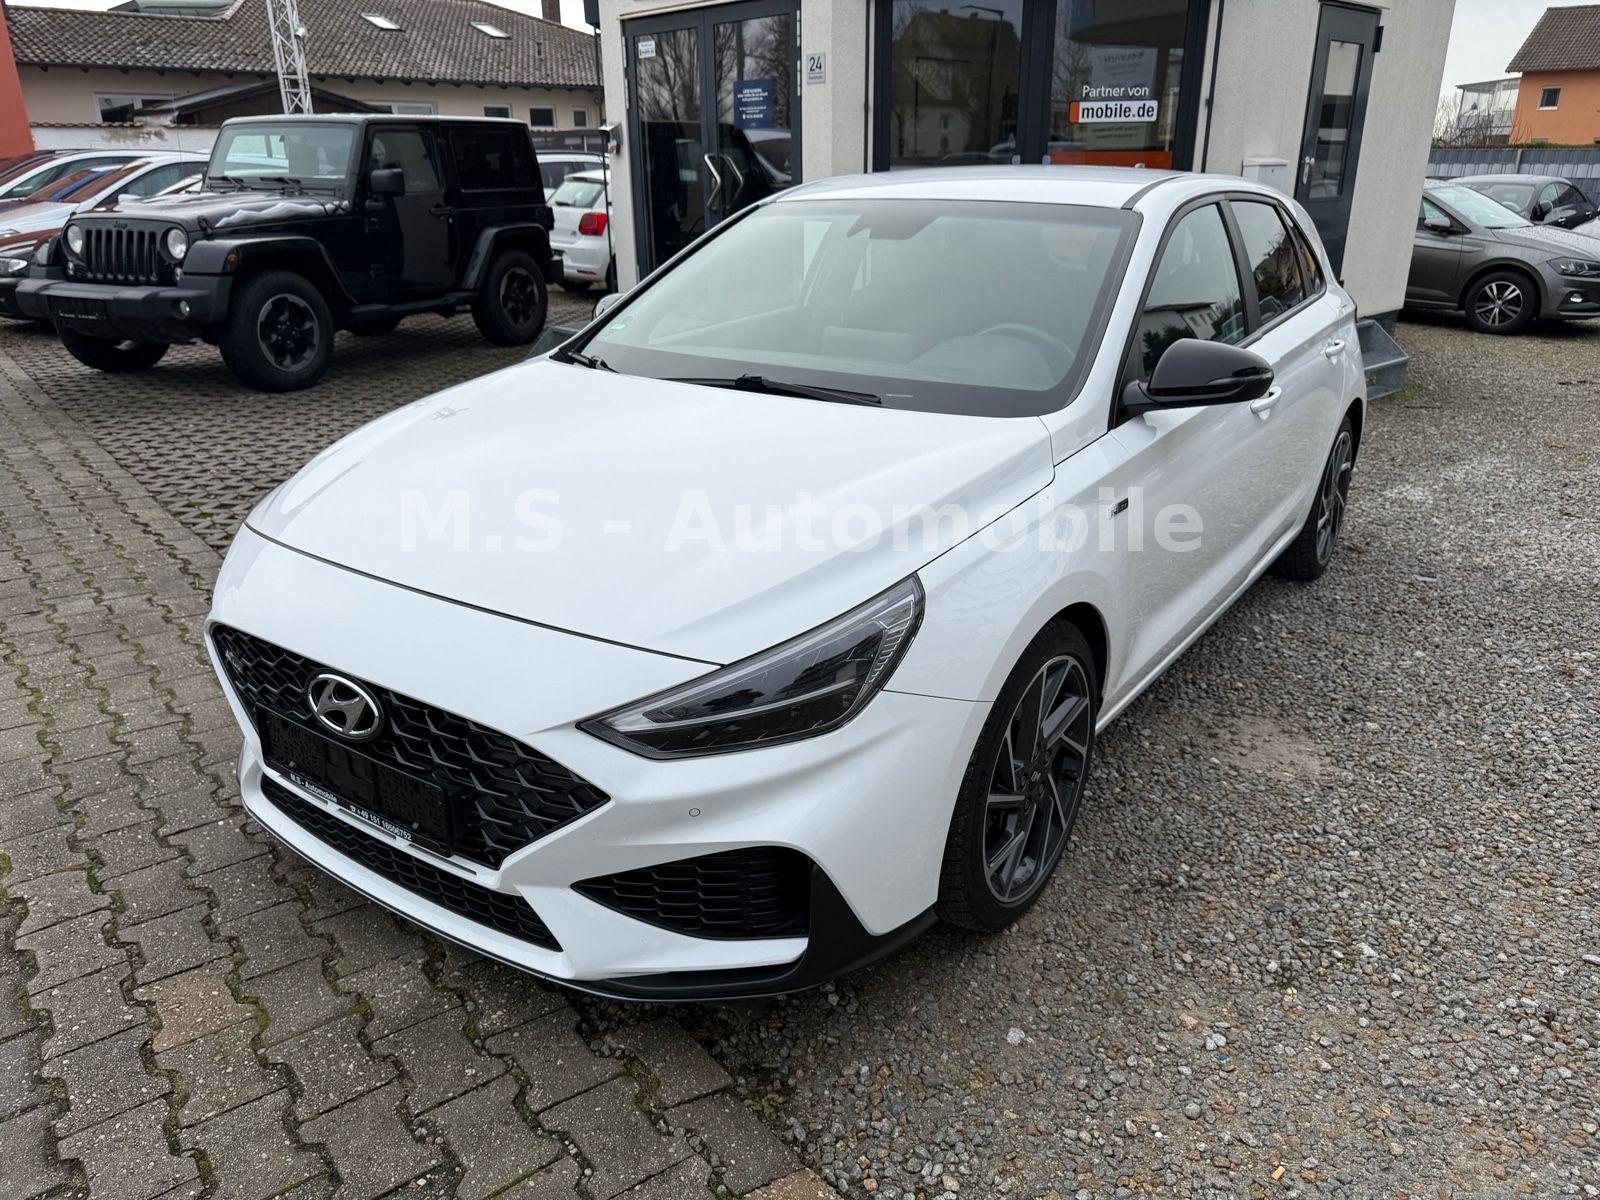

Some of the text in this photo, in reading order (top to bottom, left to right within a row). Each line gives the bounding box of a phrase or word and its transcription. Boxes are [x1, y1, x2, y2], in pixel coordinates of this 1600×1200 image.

[809, 55, 822, 72] 24
[1082, 85, 1149, 98] Partner von
[1081, 103, 1155, 119] mobile.de
[305, 781, 338, 804] Automobile
